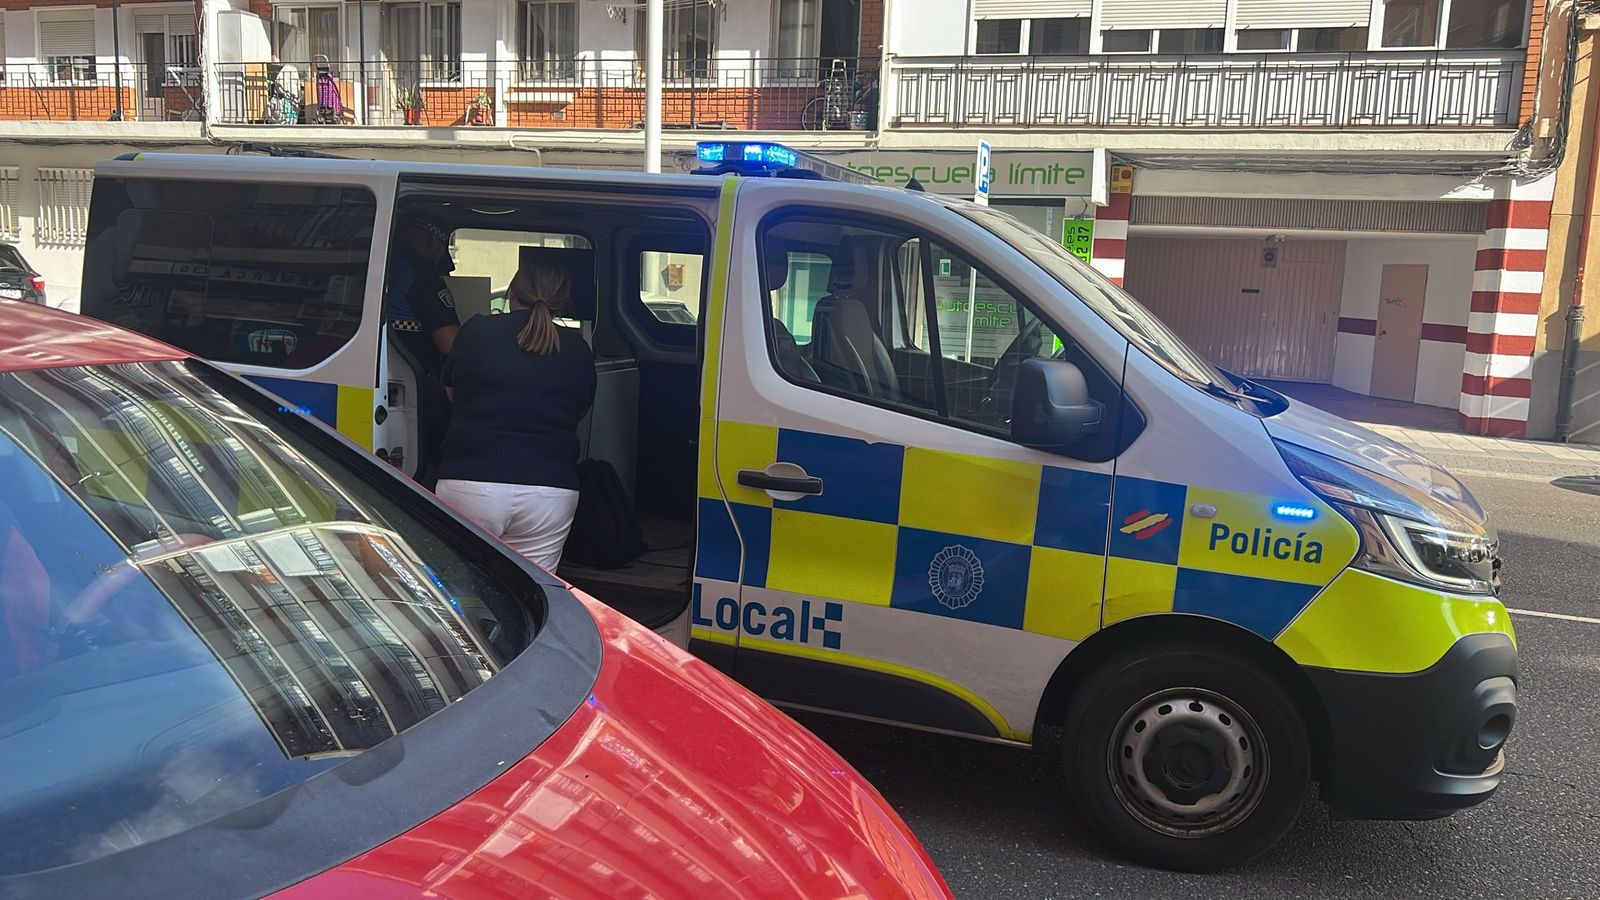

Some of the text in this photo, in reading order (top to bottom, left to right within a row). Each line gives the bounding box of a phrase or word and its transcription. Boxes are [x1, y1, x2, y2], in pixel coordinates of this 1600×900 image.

[1008, 162, 1086, 185] límite
[1077, 226, 1091, 242] 37
[1208, 522, 1323, 564] Policía
[692, 582, 811, 643] Local
